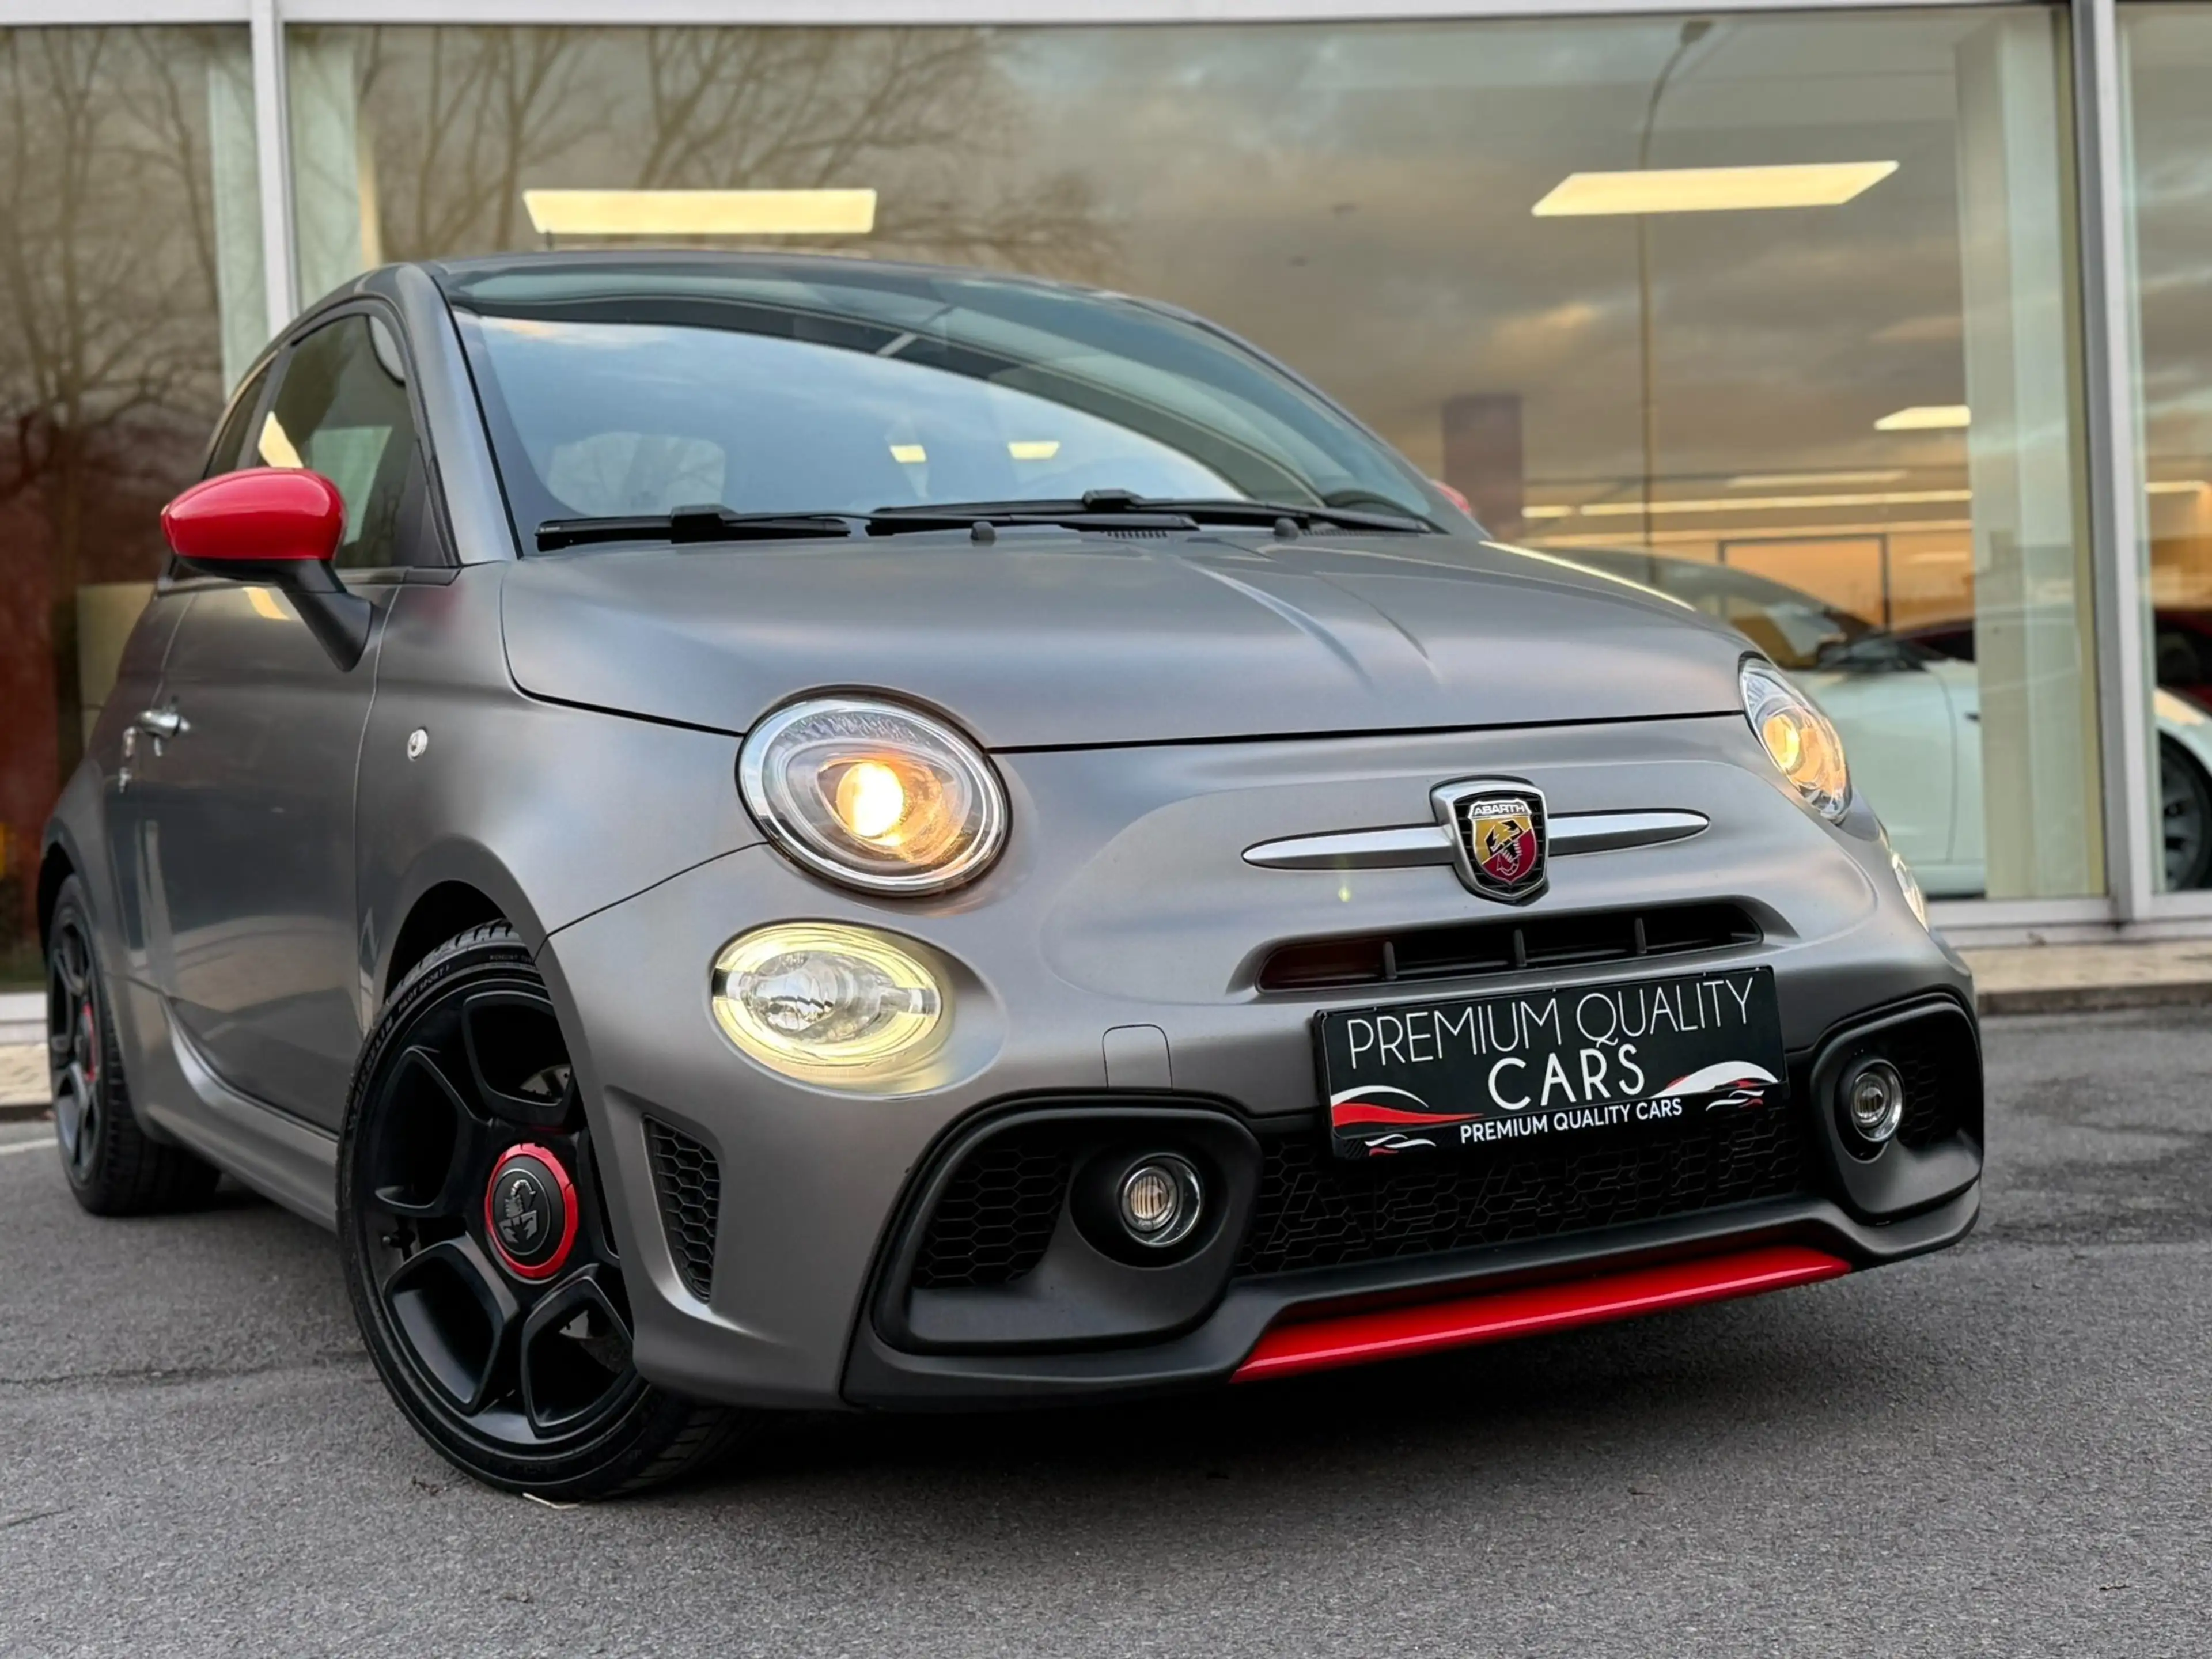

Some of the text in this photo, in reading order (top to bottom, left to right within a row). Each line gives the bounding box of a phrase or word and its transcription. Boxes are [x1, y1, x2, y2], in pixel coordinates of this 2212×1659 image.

[1474, 804, 1525, 815] ABARTH
[1346, 976, 1754, 1070] PREMIUM QUALITY
[1487, 1043, 1646, 1111] CARS
[1459, 1097, 1683, 1145] PREMIUM QUALITY CARS
